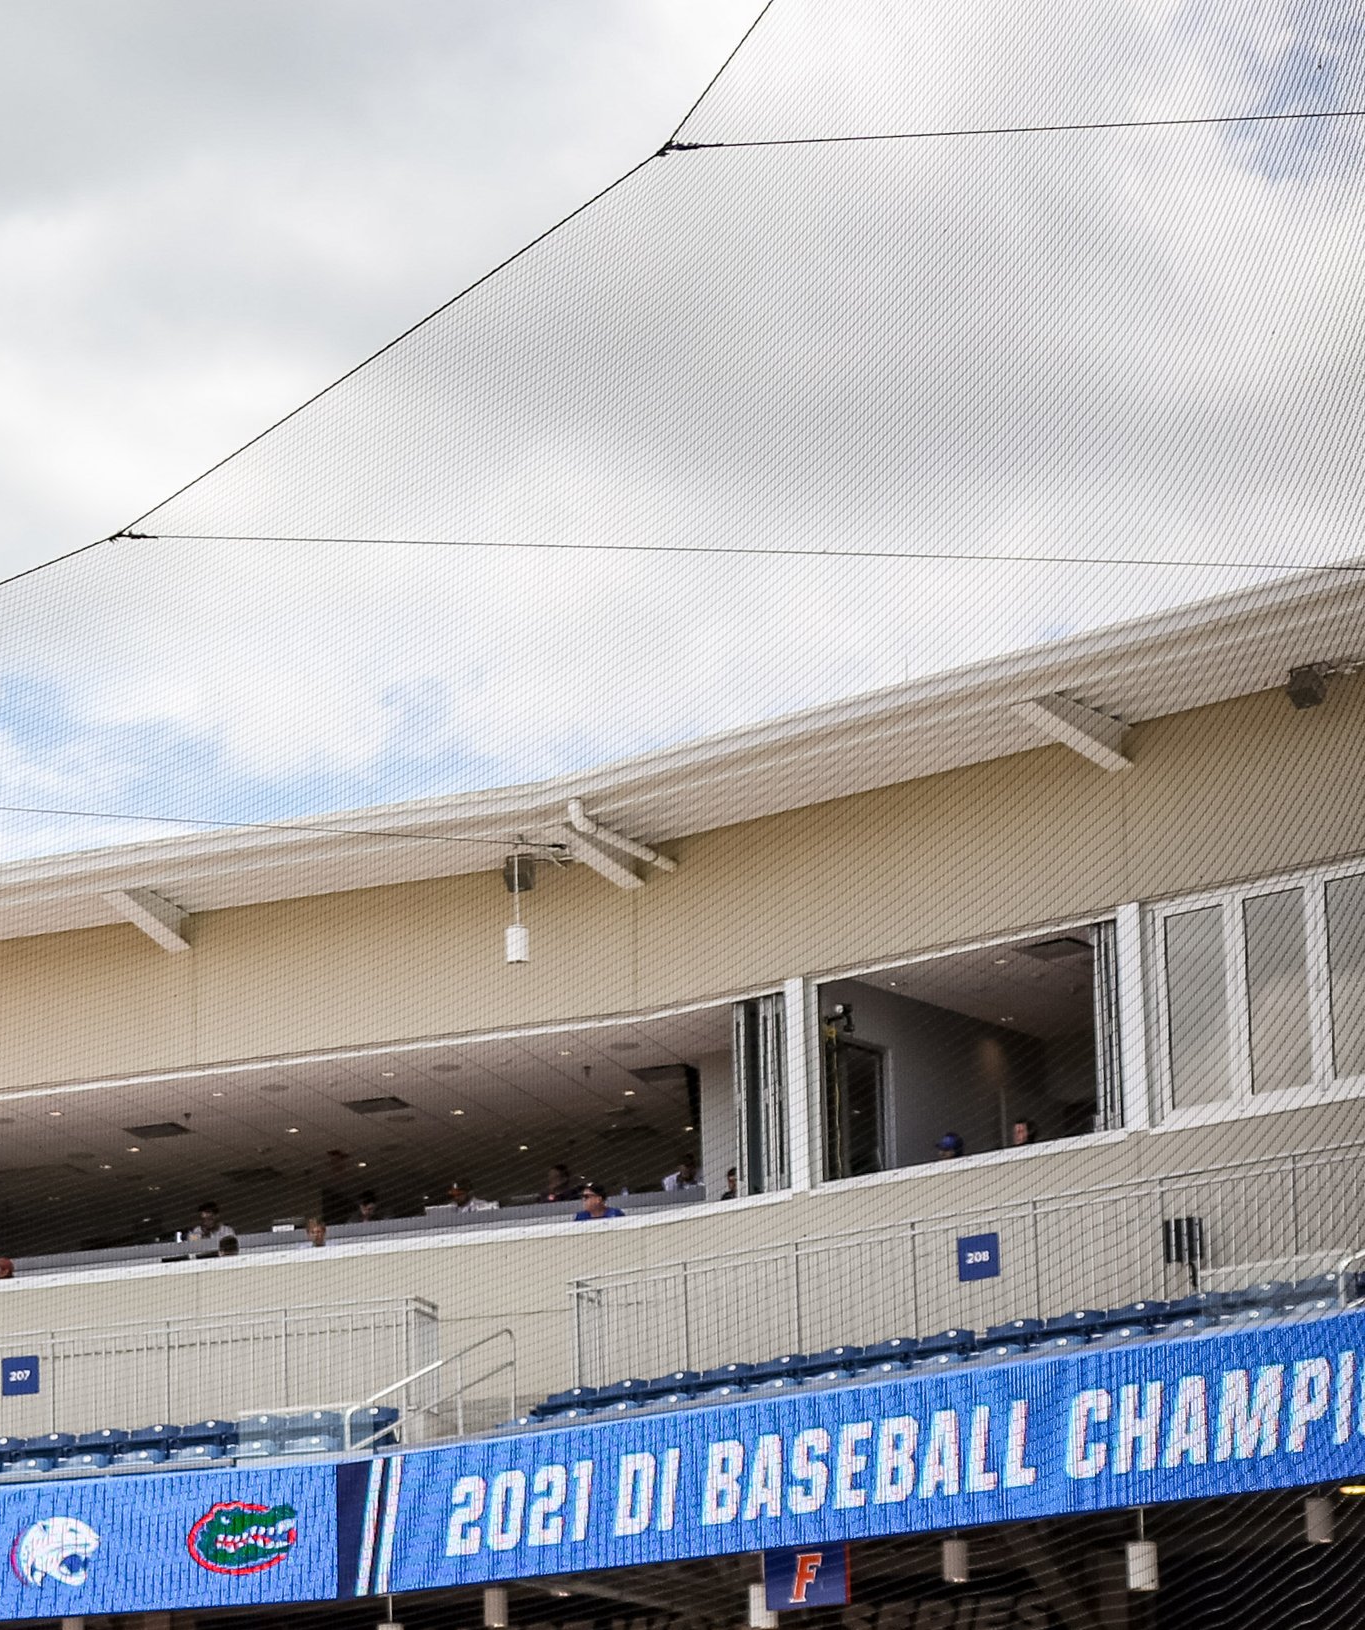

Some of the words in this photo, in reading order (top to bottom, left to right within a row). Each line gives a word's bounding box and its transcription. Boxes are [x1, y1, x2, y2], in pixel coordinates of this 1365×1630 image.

[965, 1250, 990, 1264] 208
[9, 1369, 31, 1382] 207
[446, 1459, 595, 1557] 2021
[615, 1447, 681, 1537] DI
[701, 1398, 1037, 1527] BASEBALL
[1065, 1350, 1365, 1481] CHAMPI
[789, 1552, 823, 1603] F
